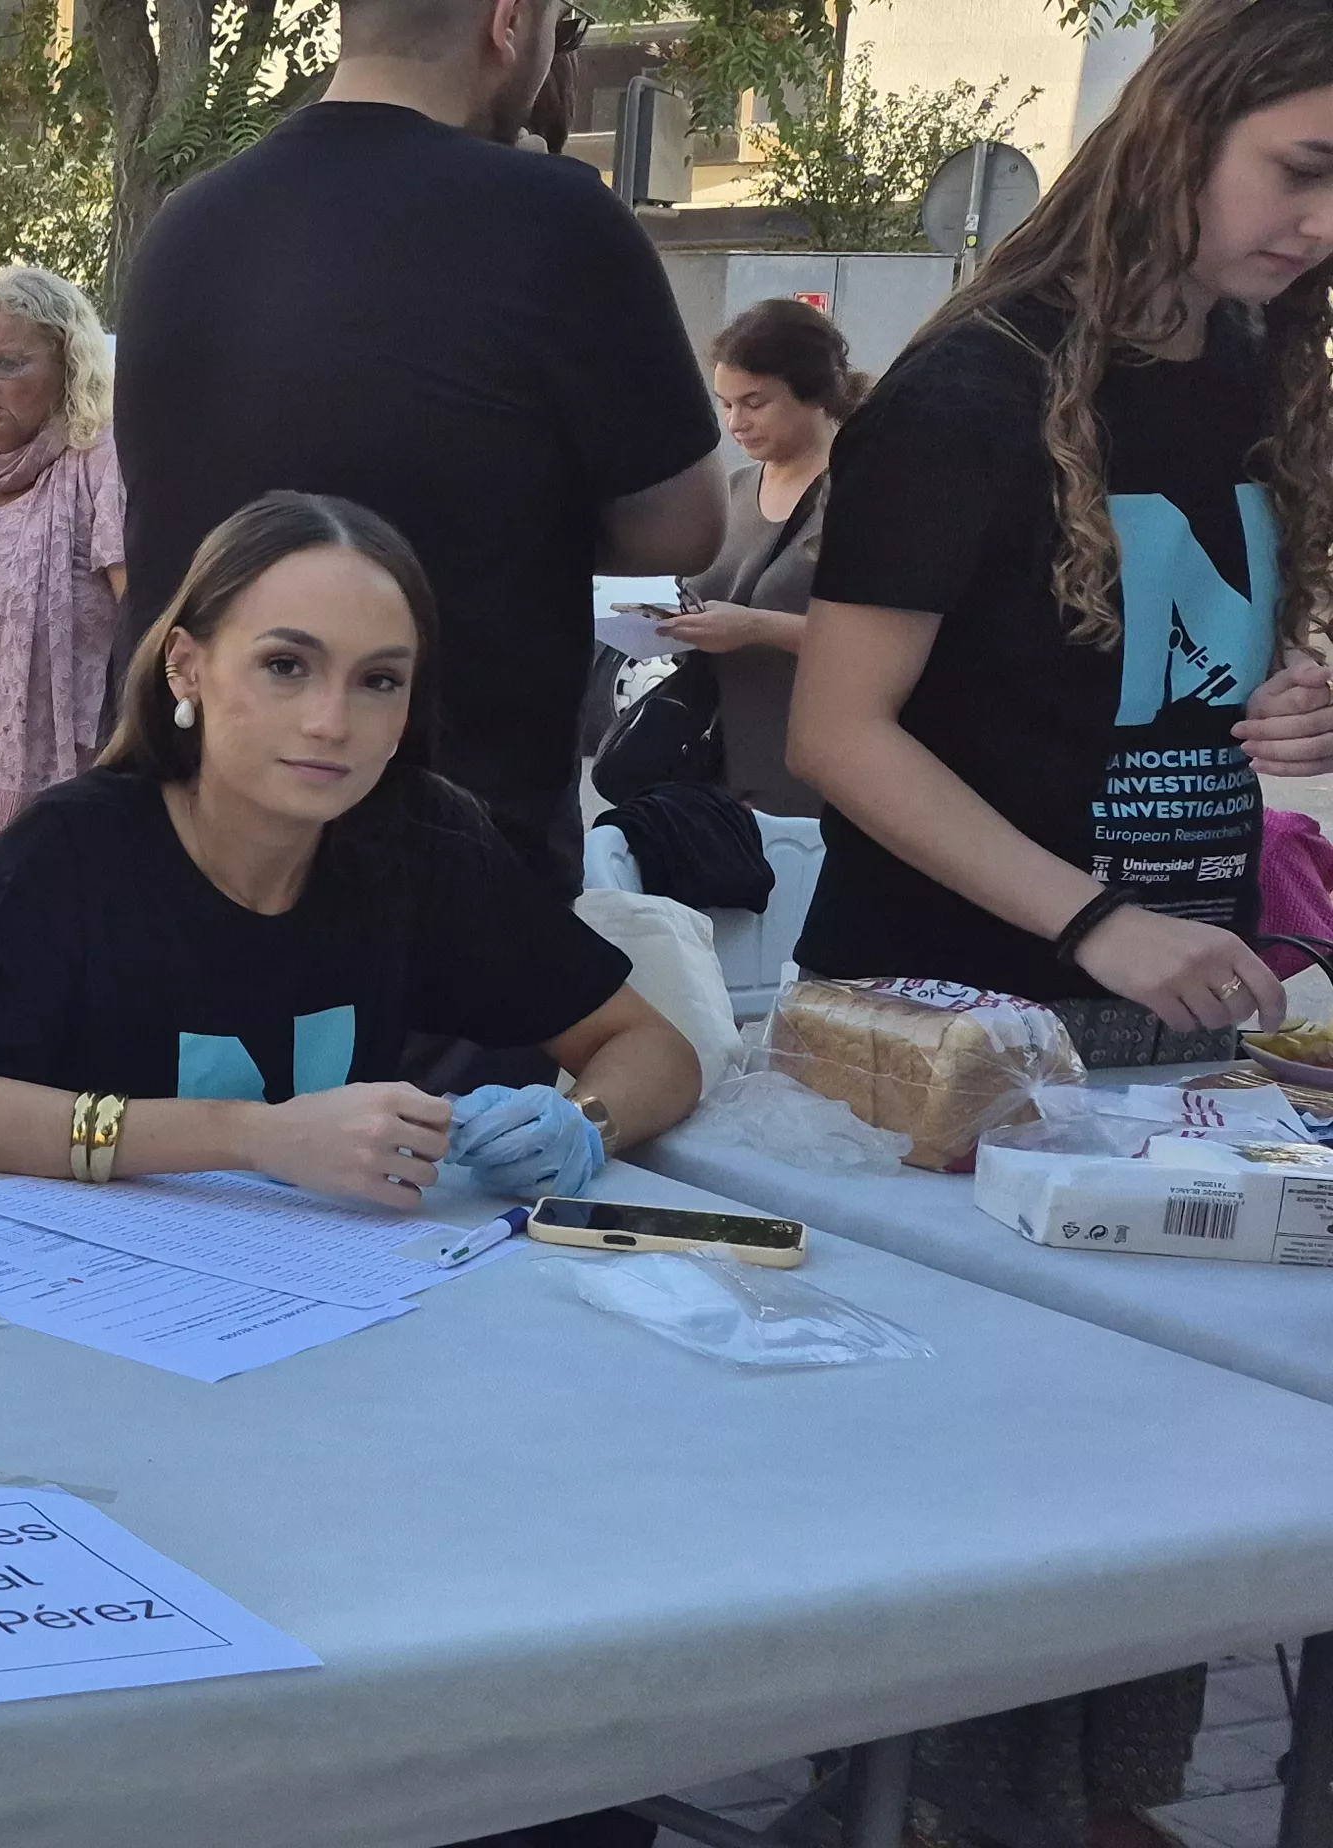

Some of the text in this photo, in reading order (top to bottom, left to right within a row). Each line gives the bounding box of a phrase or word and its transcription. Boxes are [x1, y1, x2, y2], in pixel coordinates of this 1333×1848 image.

[1125, 749, 1212, 769] NOCHE
[1092, 801, 1108, 818] E
[1095, 826, 1170, 844] European
[1123, 858, 1194, 872] Universidad
[1121, 872, 1169, 884] Zaragoza
